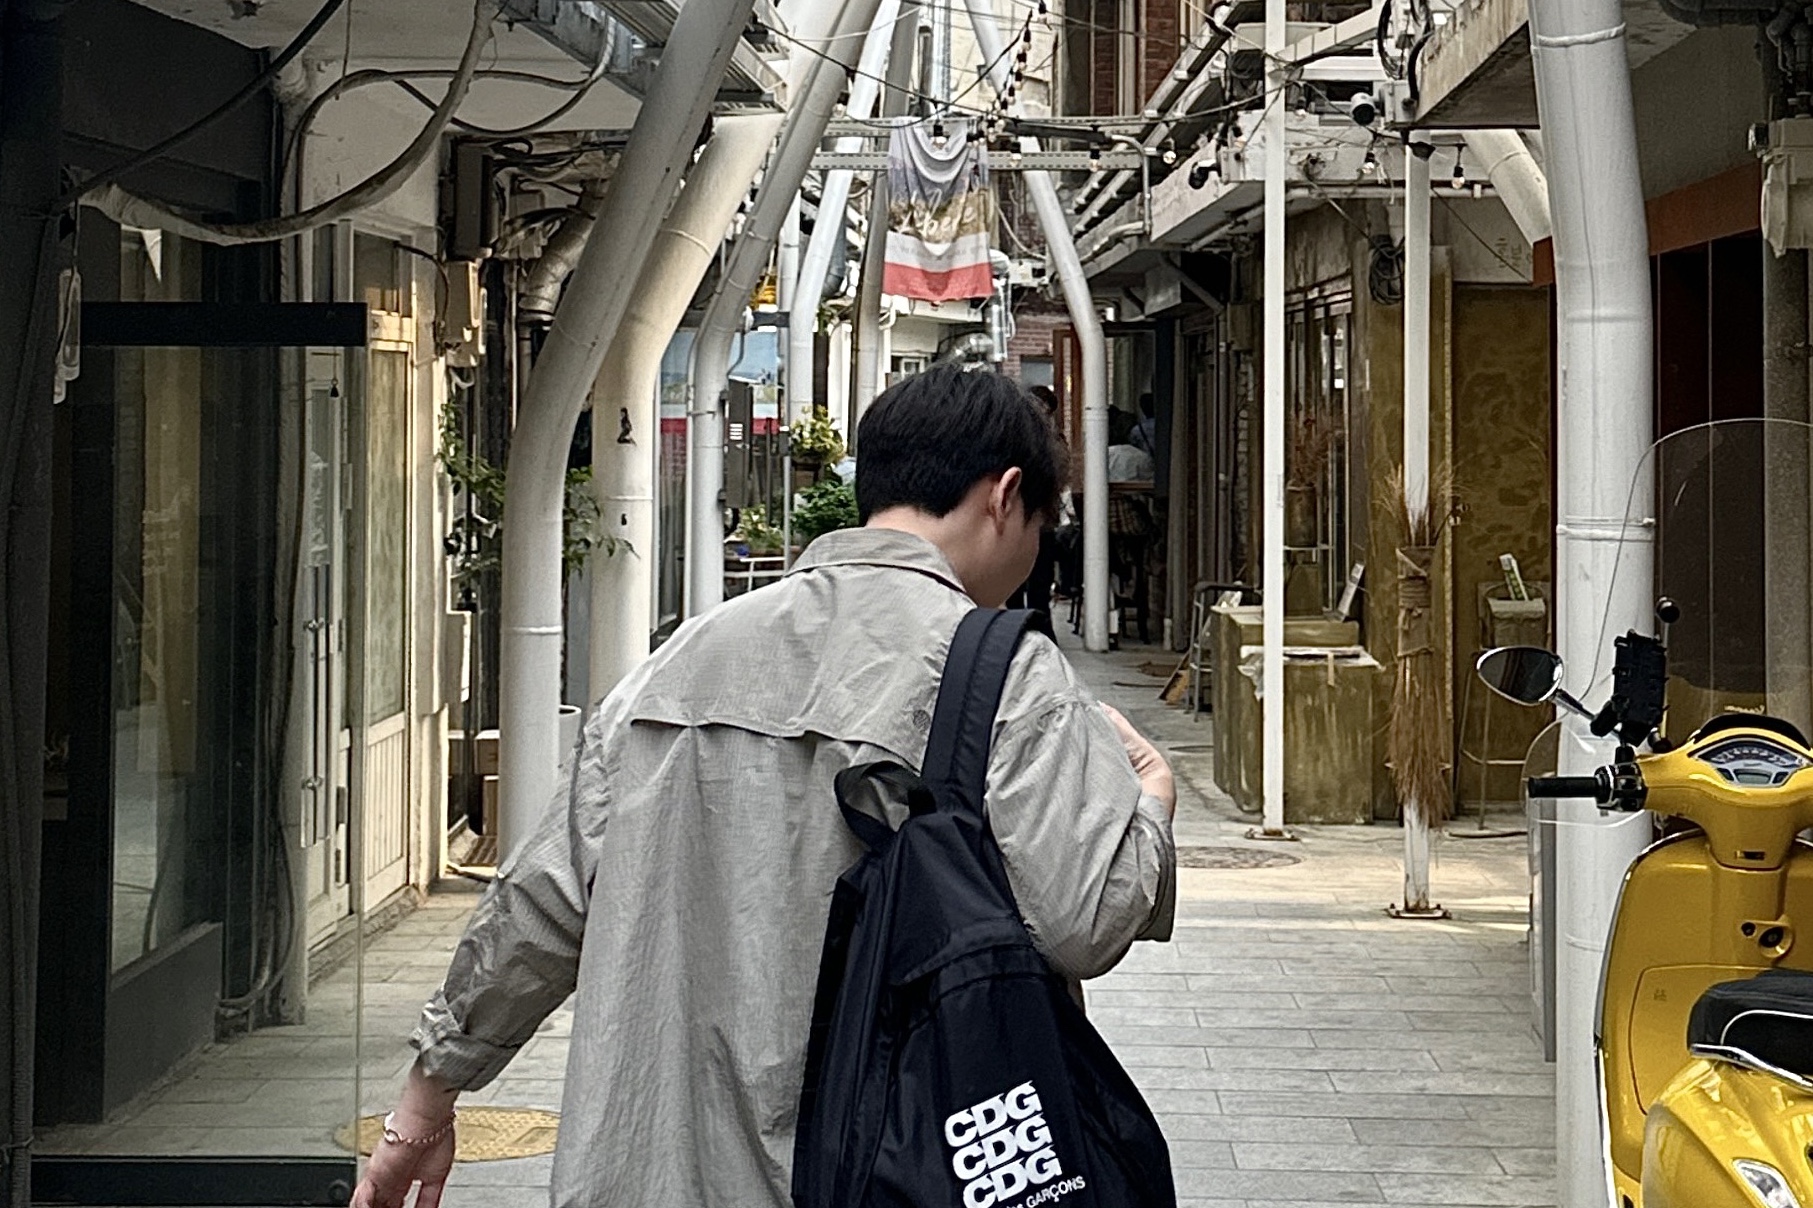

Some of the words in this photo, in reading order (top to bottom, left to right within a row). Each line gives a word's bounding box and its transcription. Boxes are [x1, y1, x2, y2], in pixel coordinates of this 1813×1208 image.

[944, 1080, 1043, 1147] CDG
[952, 1112, 1053, 1180] CDG
[1026, 1175, 1086, 1208] GARÇONS
